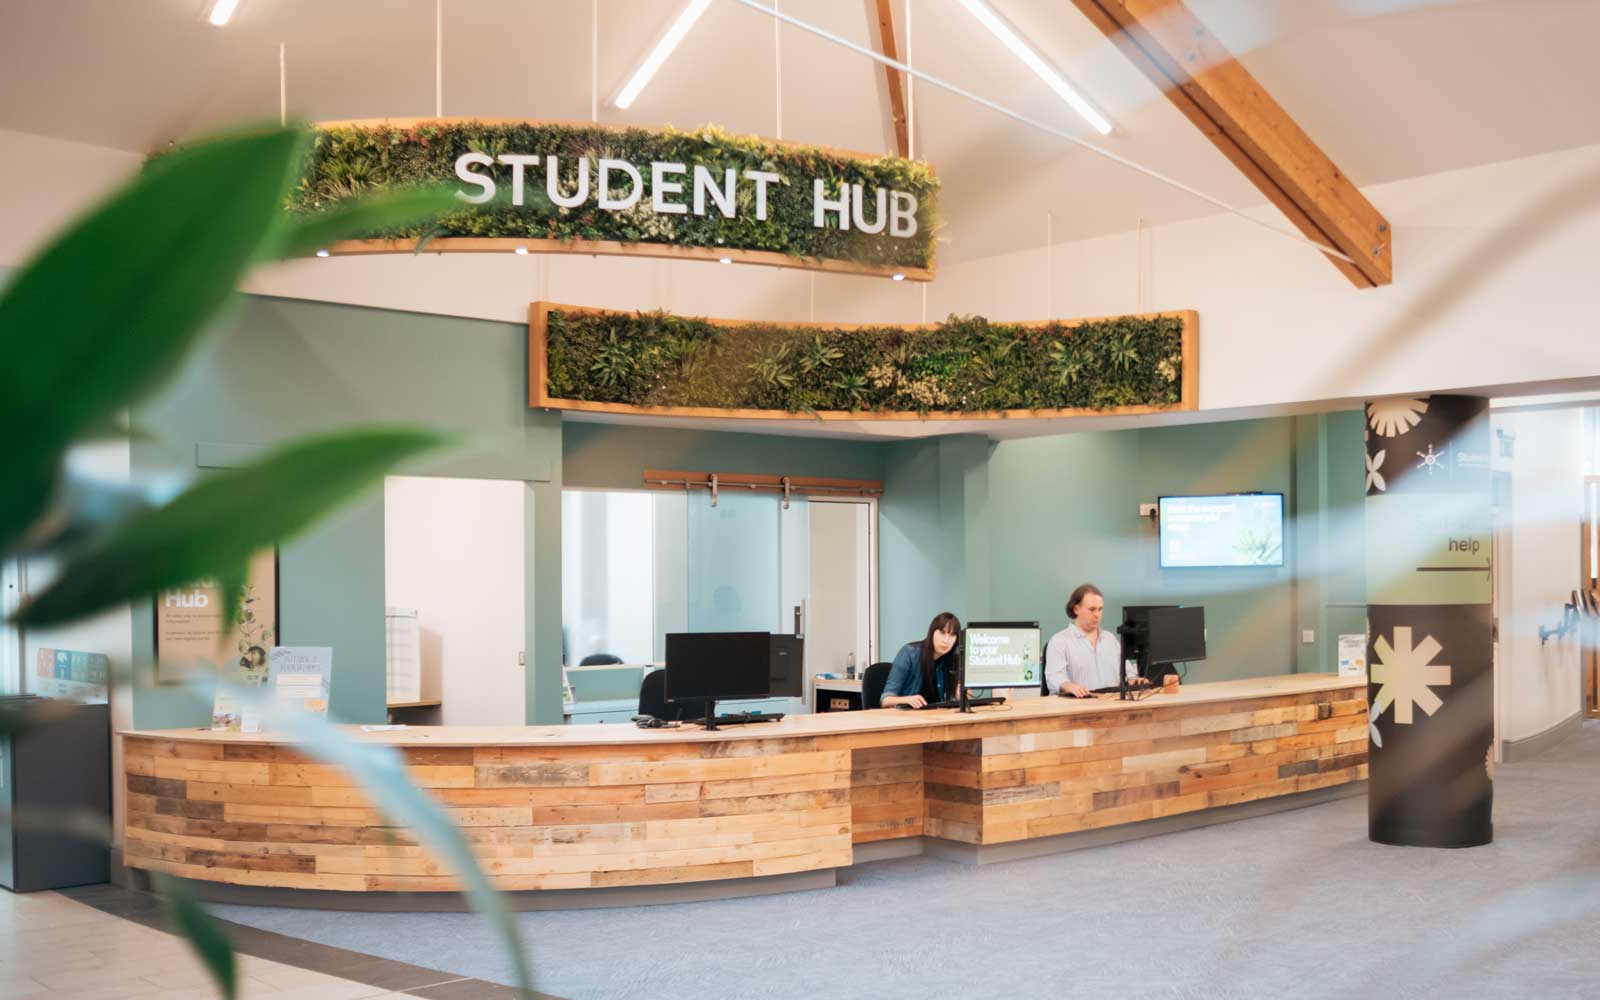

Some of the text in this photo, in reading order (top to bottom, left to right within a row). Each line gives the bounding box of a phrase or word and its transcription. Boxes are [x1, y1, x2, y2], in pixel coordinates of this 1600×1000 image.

[454, 152, 918, 238] STUDENT HUB
[1448, 537, 1480, 555] help
[165, 590, 209, 608] Hub
[970, 633, 1009, 645] Welcome
[969, 654, 1021, 665] Student Hub
